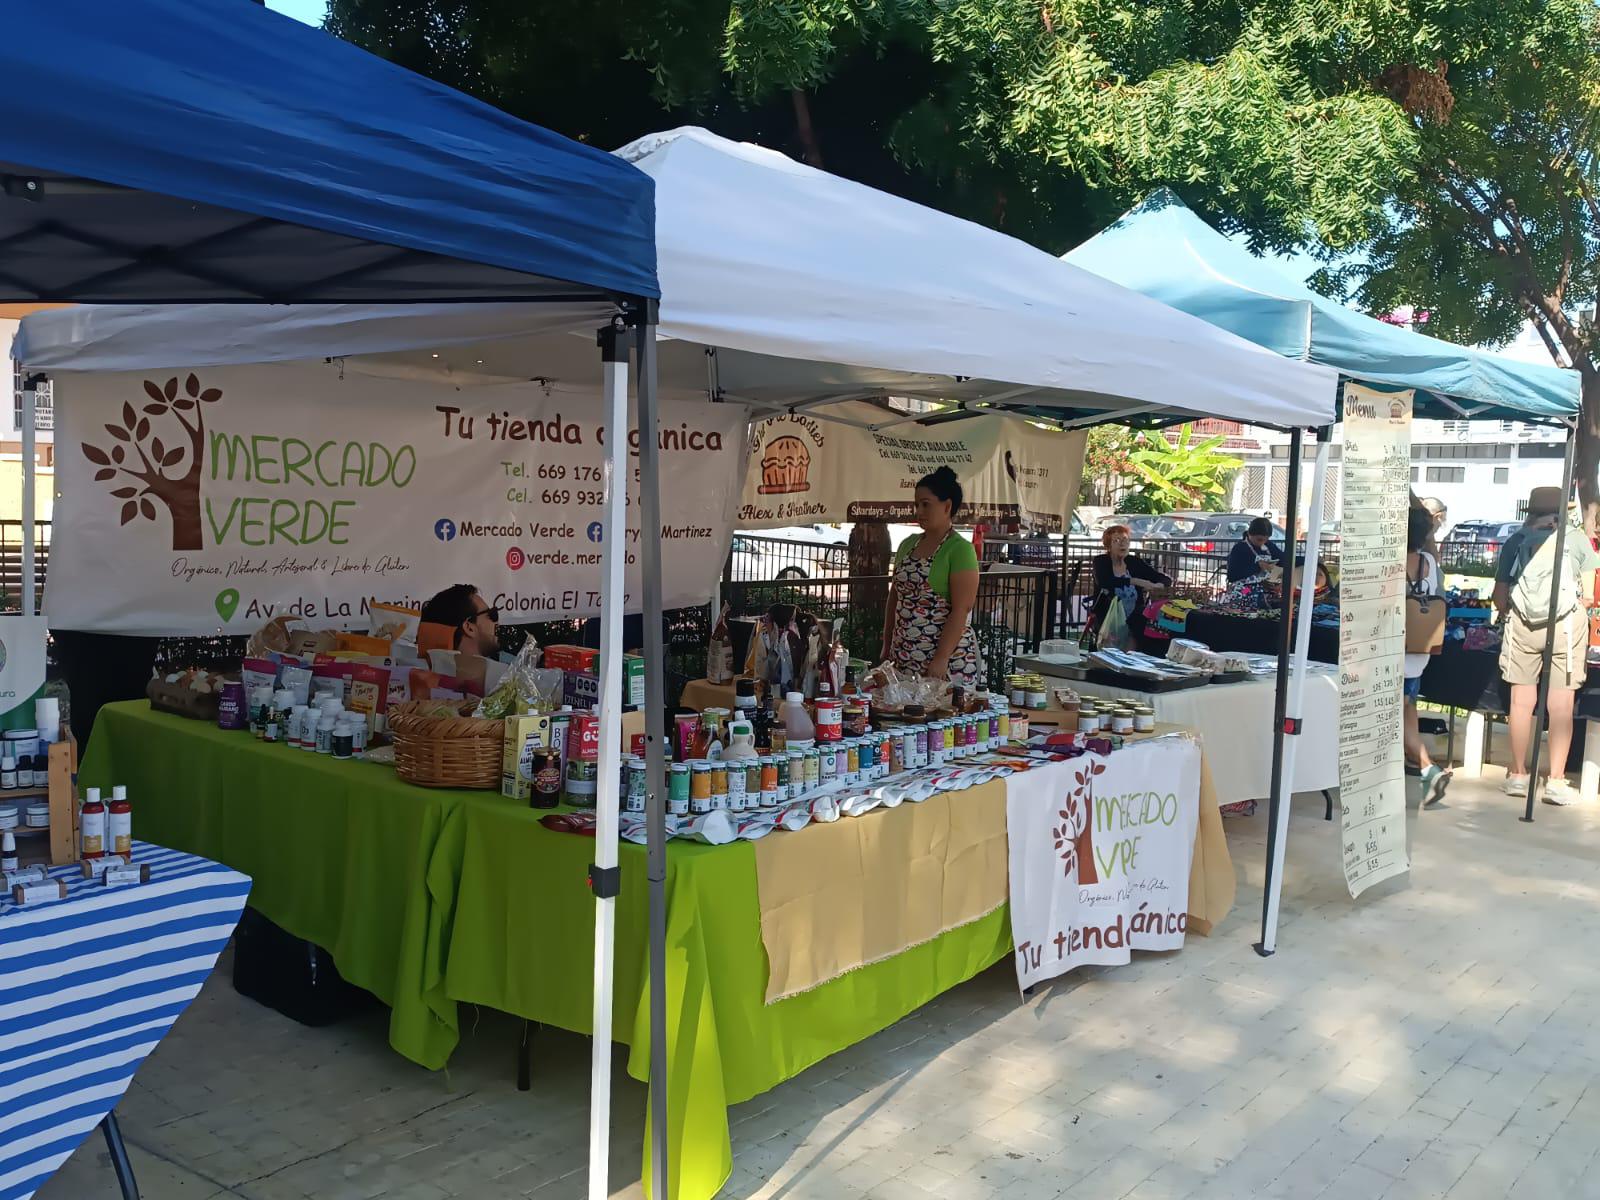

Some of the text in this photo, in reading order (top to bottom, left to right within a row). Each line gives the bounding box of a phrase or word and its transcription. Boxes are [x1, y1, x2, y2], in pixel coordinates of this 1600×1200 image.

[1345, 395, 1376, 419] Menu
[435, 405, 473, 440] Tu
[487, 411, 582, 446] tienda
[209, 429, 417, 488] MERCADO
[501, 461, 602, 482] Tel. 669 176
[506, 487, 532, 504] Cel.
[541, 489, 570, 505] 669
[577, 491, 605, 506] 932
[205, 496, 357, 546] VERDE
[738, 504, 774, 520] Alex
[777, 502, 785, 518] &
[851, 505, 884, 518] Saturdays
[460, 521, 575, 539] Mercado Verde
[661, 525, 712, 539] Martinez
[289, 596, 318, 618] de
[325, 596, 352, 617] La
[493, 591, 557, 612] Colonia
[561, 590, 579, 610] El
[1018, 940, 1042, 975] Tu
